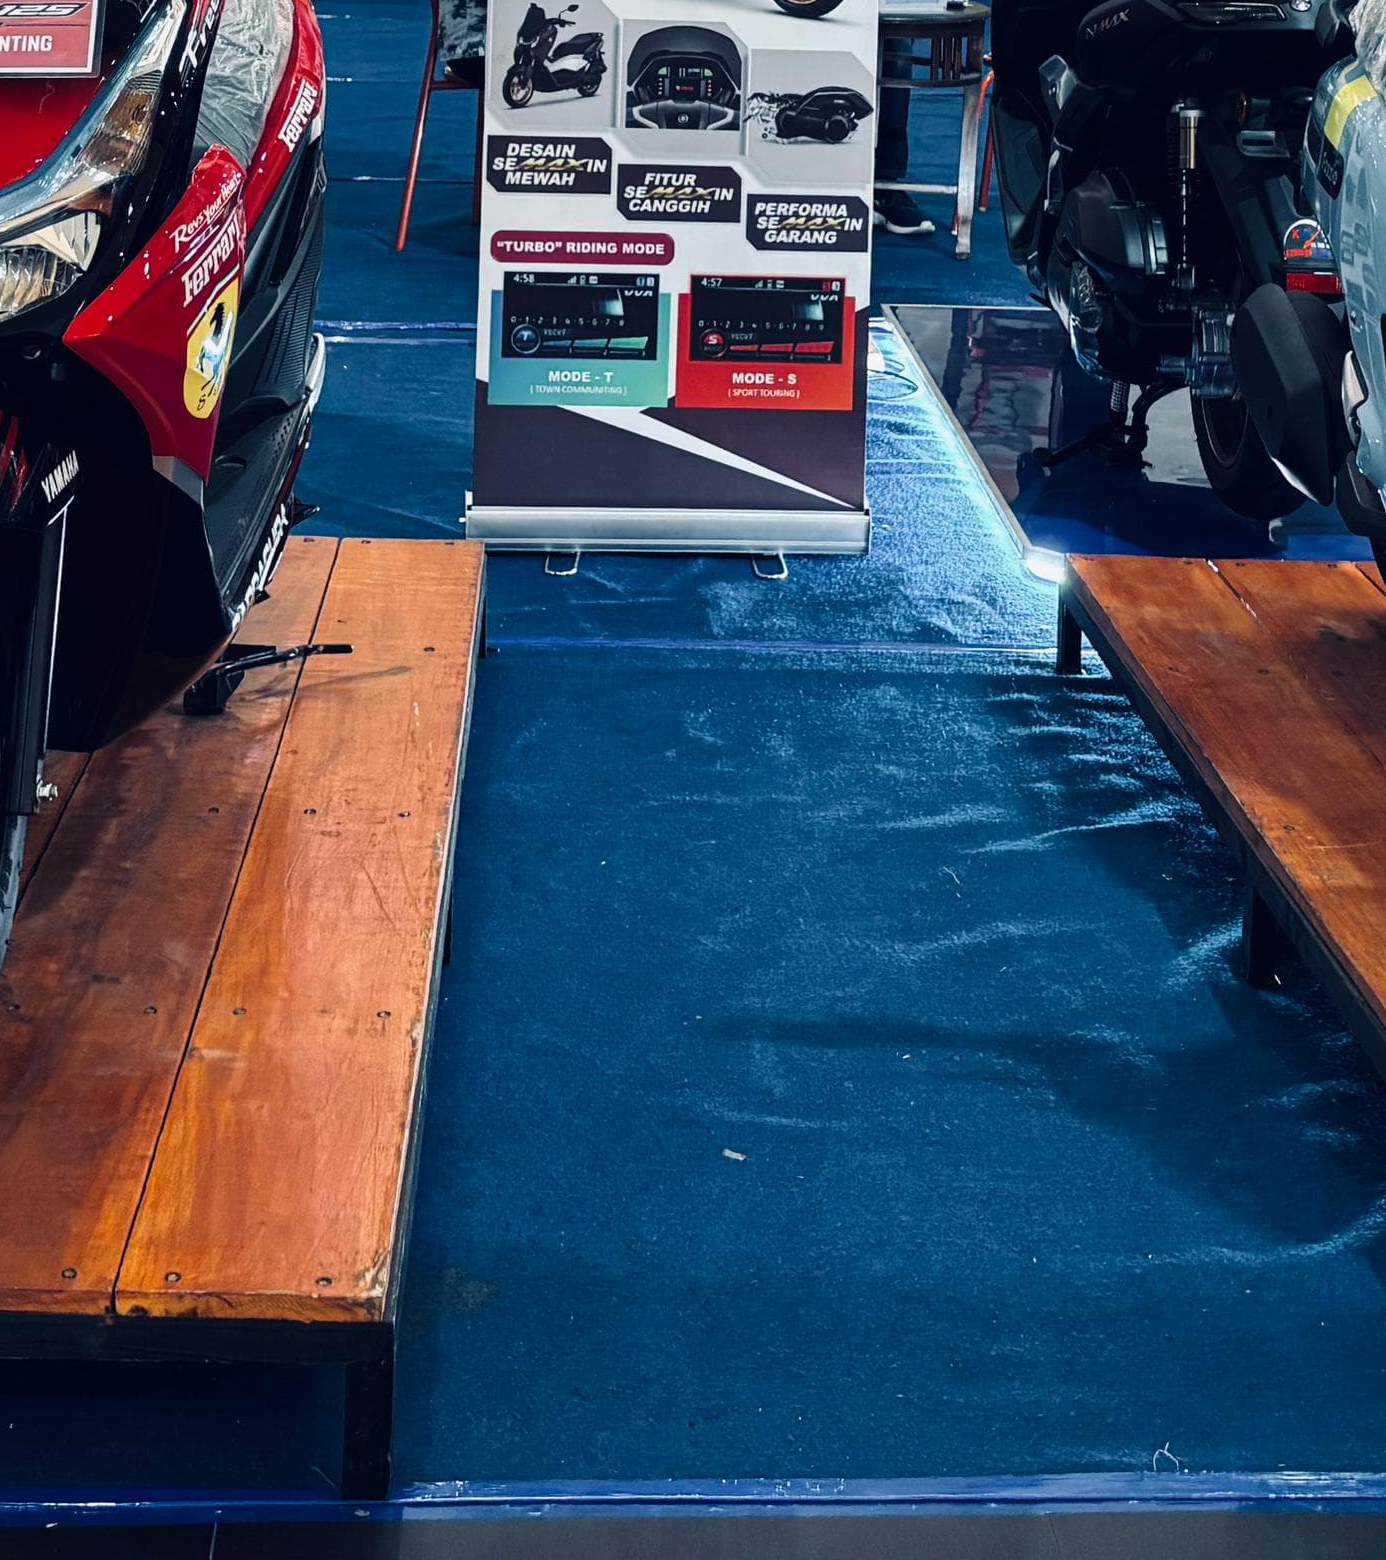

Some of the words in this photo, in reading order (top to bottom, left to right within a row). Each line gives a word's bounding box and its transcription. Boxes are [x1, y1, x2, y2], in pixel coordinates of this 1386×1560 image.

[506, 142, 576, 158] DESAIN
[504, 171, 576, 186] MEWAH
[644, 172, 697, 187] FITUR
[628, 198, 711, 214] CANGGIH
[754, 202, 848, 218] PERFORMA
[169, 215, 205, 253] Revs
[202, 194, 225, 223] Your
[764, 230, 838, 244] GARANG
[566, 242, 618, 254] RIDING
[622, 243, 665, 255] MODE
[181, 212, 241, 308] Ferrari
[701, 278, 723, 287] 4:57
[548, 371, 591, 383] MODE
[603, 372, 614, 383] T
[732, 373, 775, 384] MODE
[787, 373, 797, 385] S
[40, 449, 79, 503] YAMAHA
